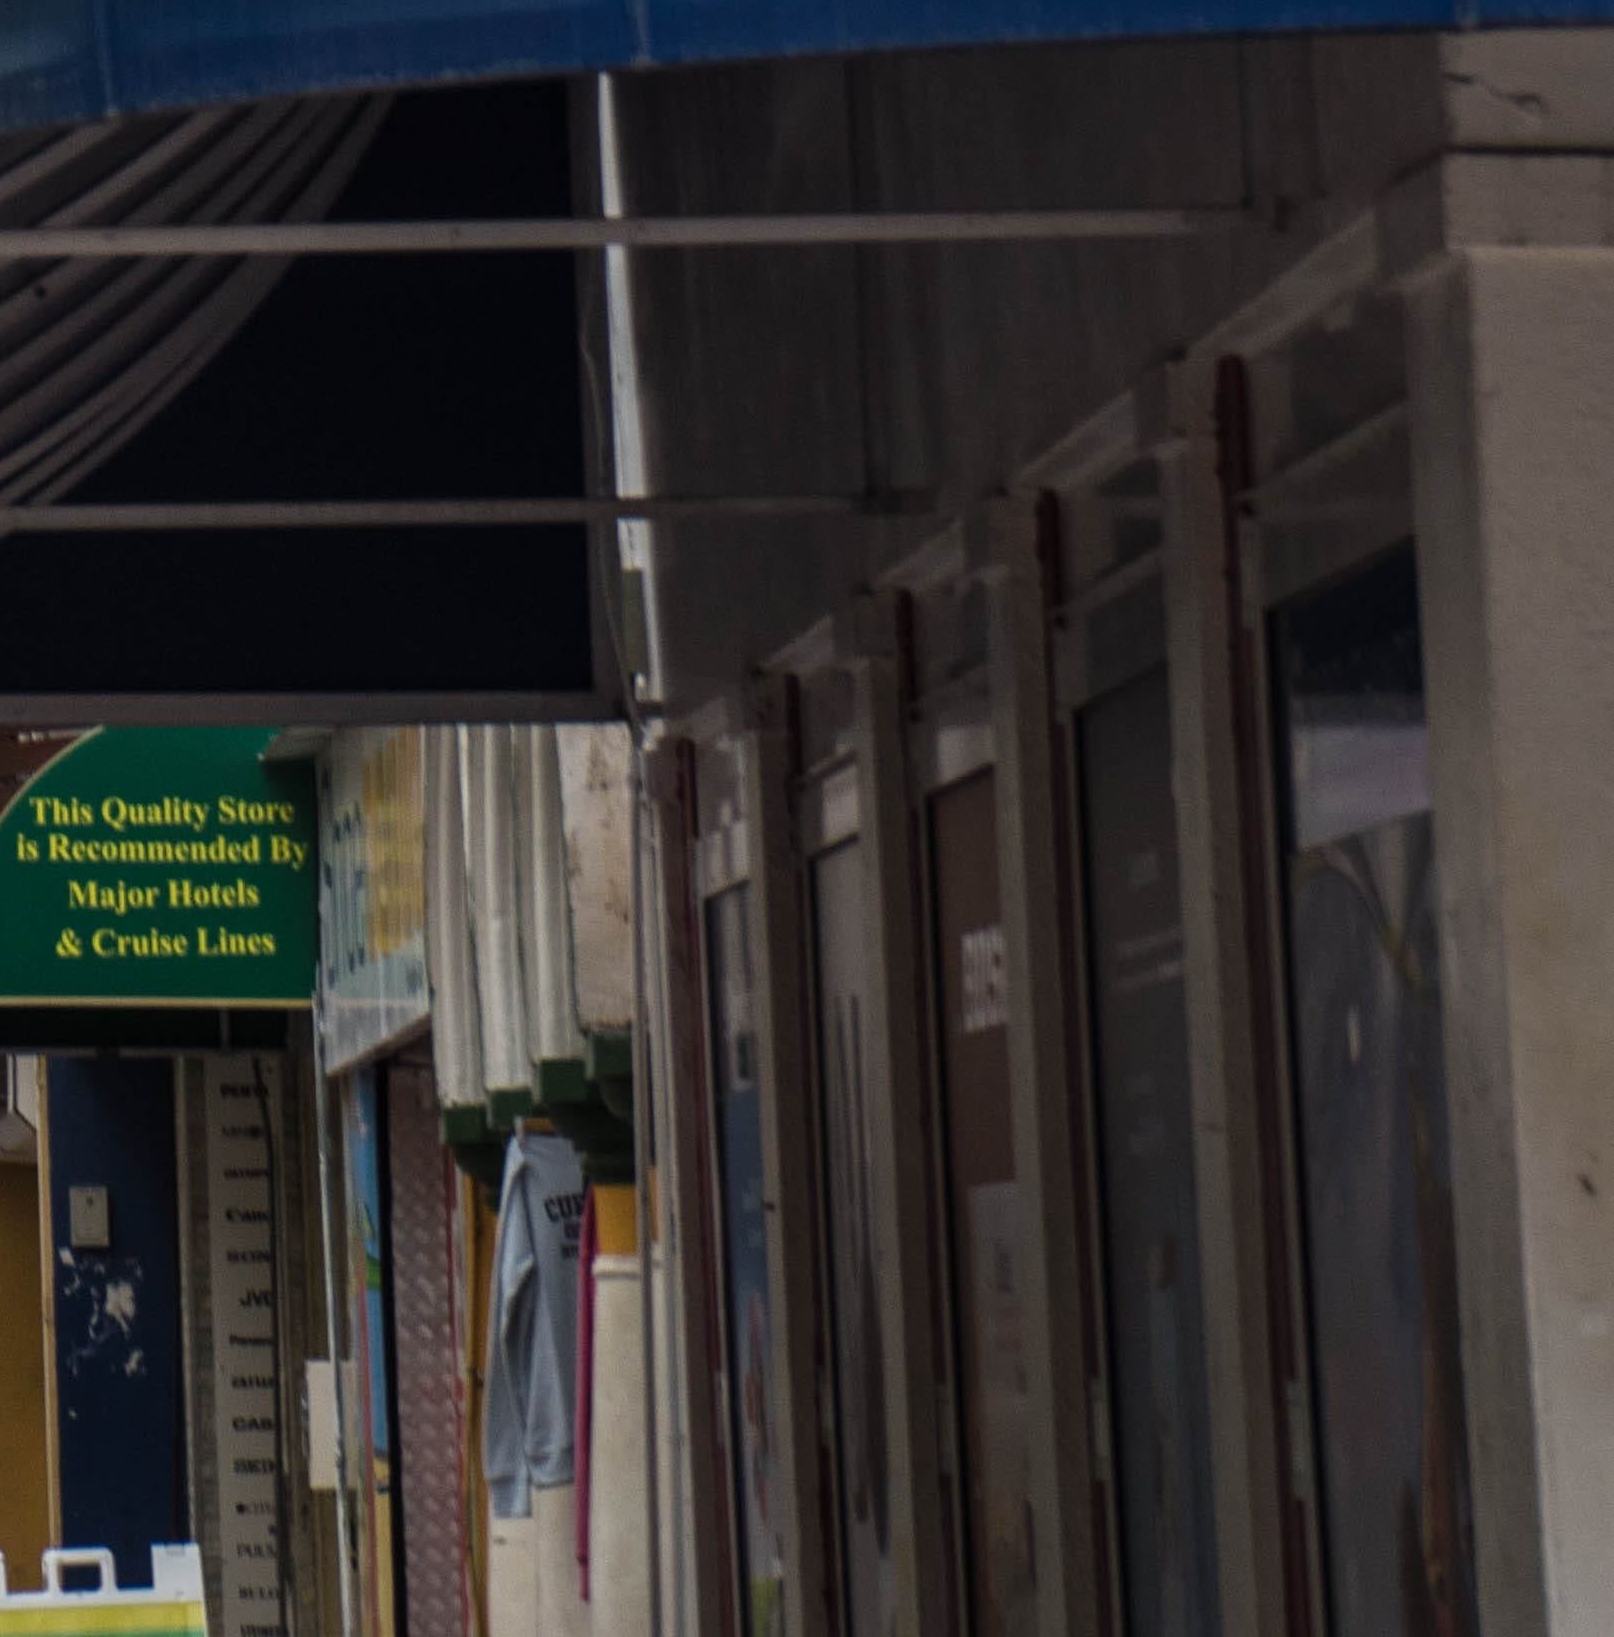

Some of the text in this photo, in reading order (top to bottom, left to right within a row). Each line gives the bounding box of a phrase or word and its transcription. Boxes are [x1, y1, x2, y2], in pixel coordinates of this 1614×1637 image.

[28, 794, 295, 832] This Quality Store
[16, 832, 309, 871] is Recommended By
[68, 878, 260, 916] Major Hotels
[55, 926, 277, 959] & Cruise Lines
